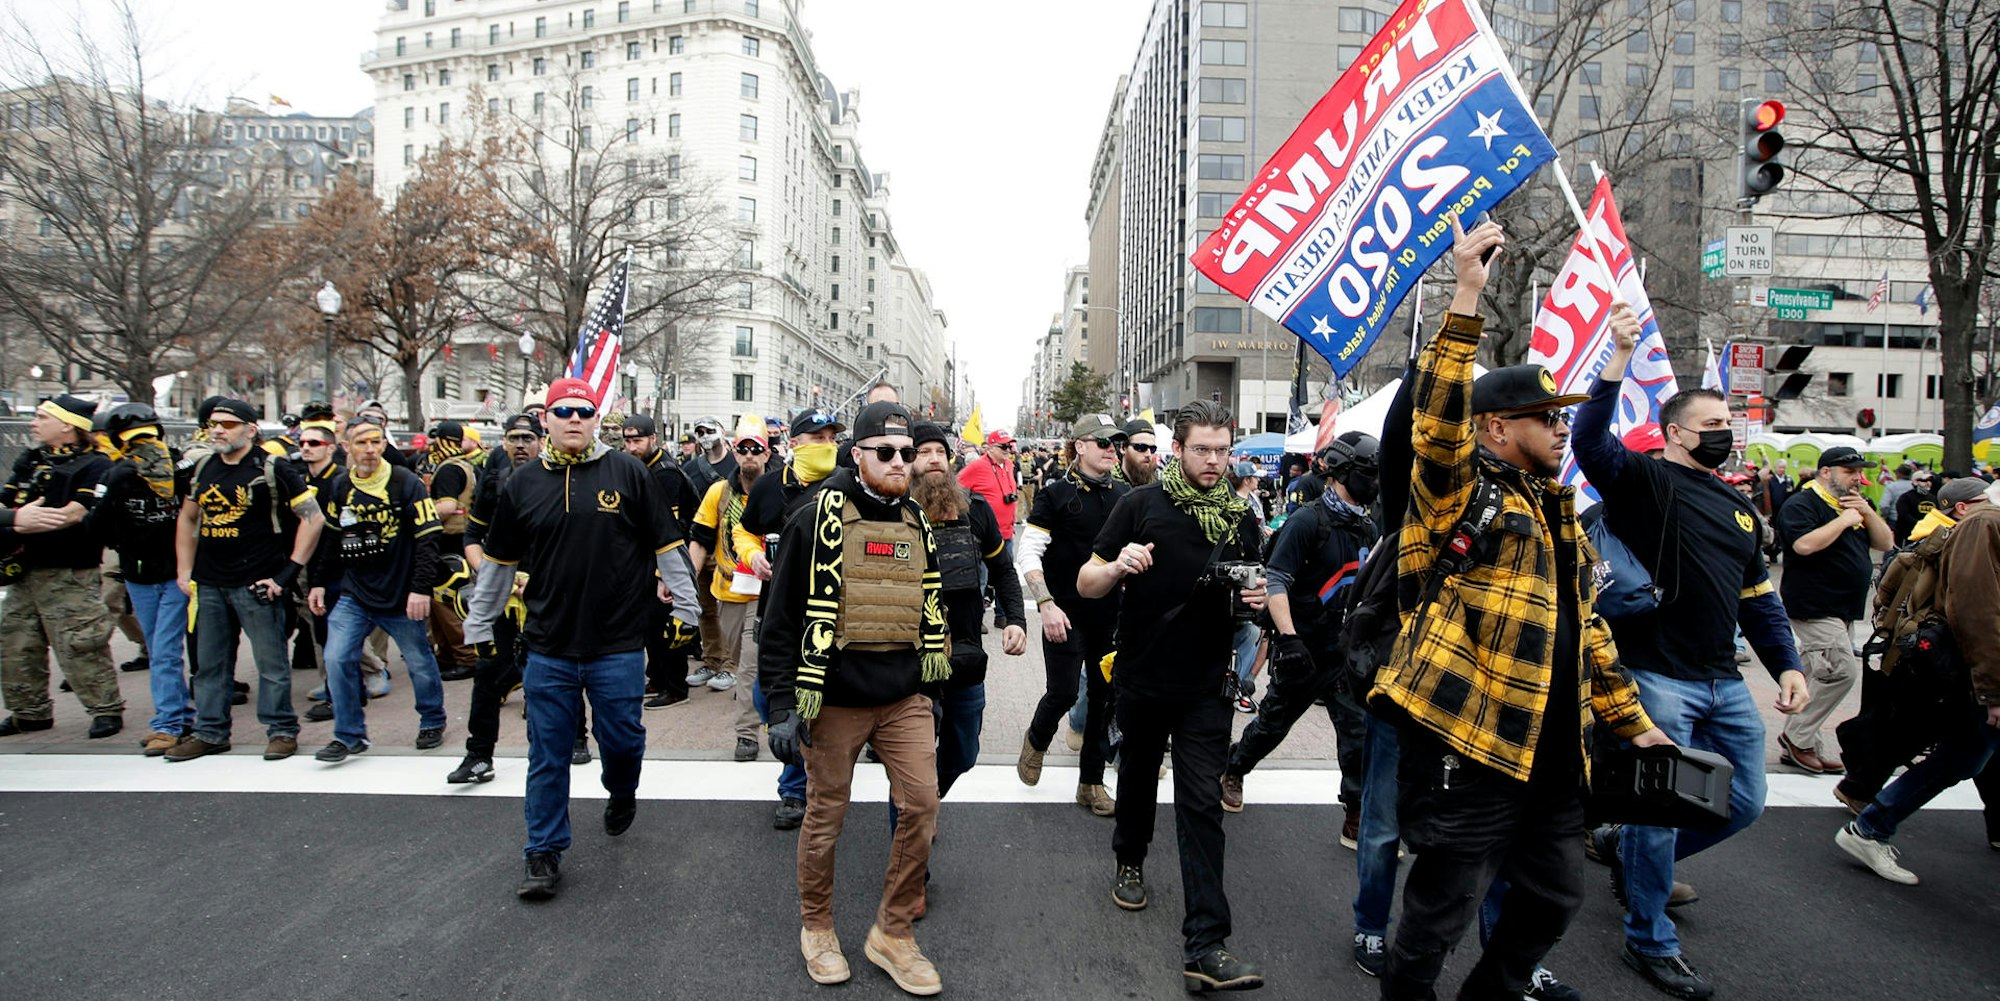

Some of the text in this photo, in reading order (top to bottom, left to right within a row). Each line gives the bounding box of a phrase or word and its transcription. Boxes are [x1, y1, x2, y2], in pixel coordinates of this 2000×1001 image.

[1741, 233, 1759, 243] NO
[1734, 246, 1766, 256] TURN
[1729, 259, 1770, 270] ON RED
[1770, 289, 1820, 308] Pennsylvania
[1780, 308, 1804, 319] 1300
[1212, 339, 1229, 350] JW
[210, 527, 240, 538] BOYS
[866, 541, 895, 555] RWDS
